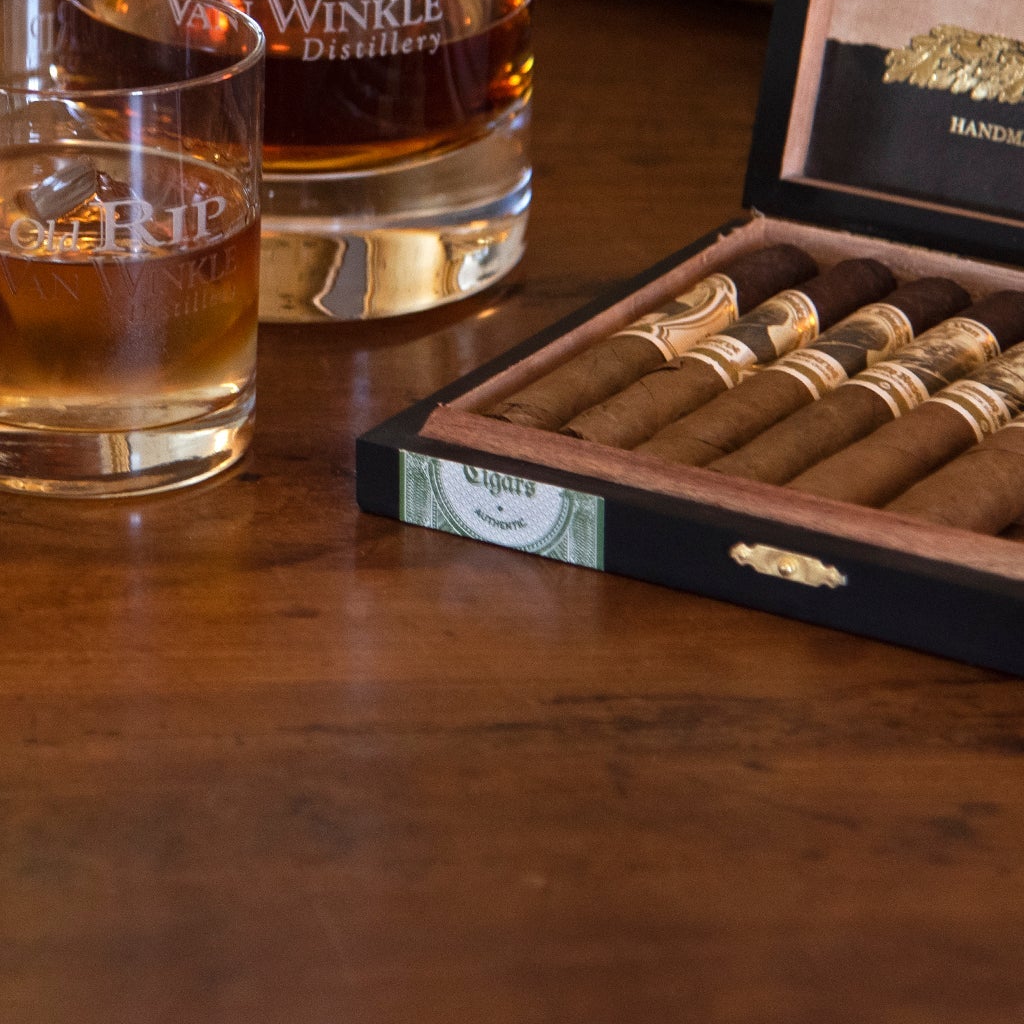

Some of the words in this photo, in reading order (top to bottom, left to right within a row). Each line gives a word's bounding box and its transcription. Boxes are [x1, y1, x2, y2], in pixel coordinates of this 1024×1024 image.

[302, 31, 442, 62] Distillery
[9, 217, 81, 252] Old
[88, 195, 227, 253] RIP
